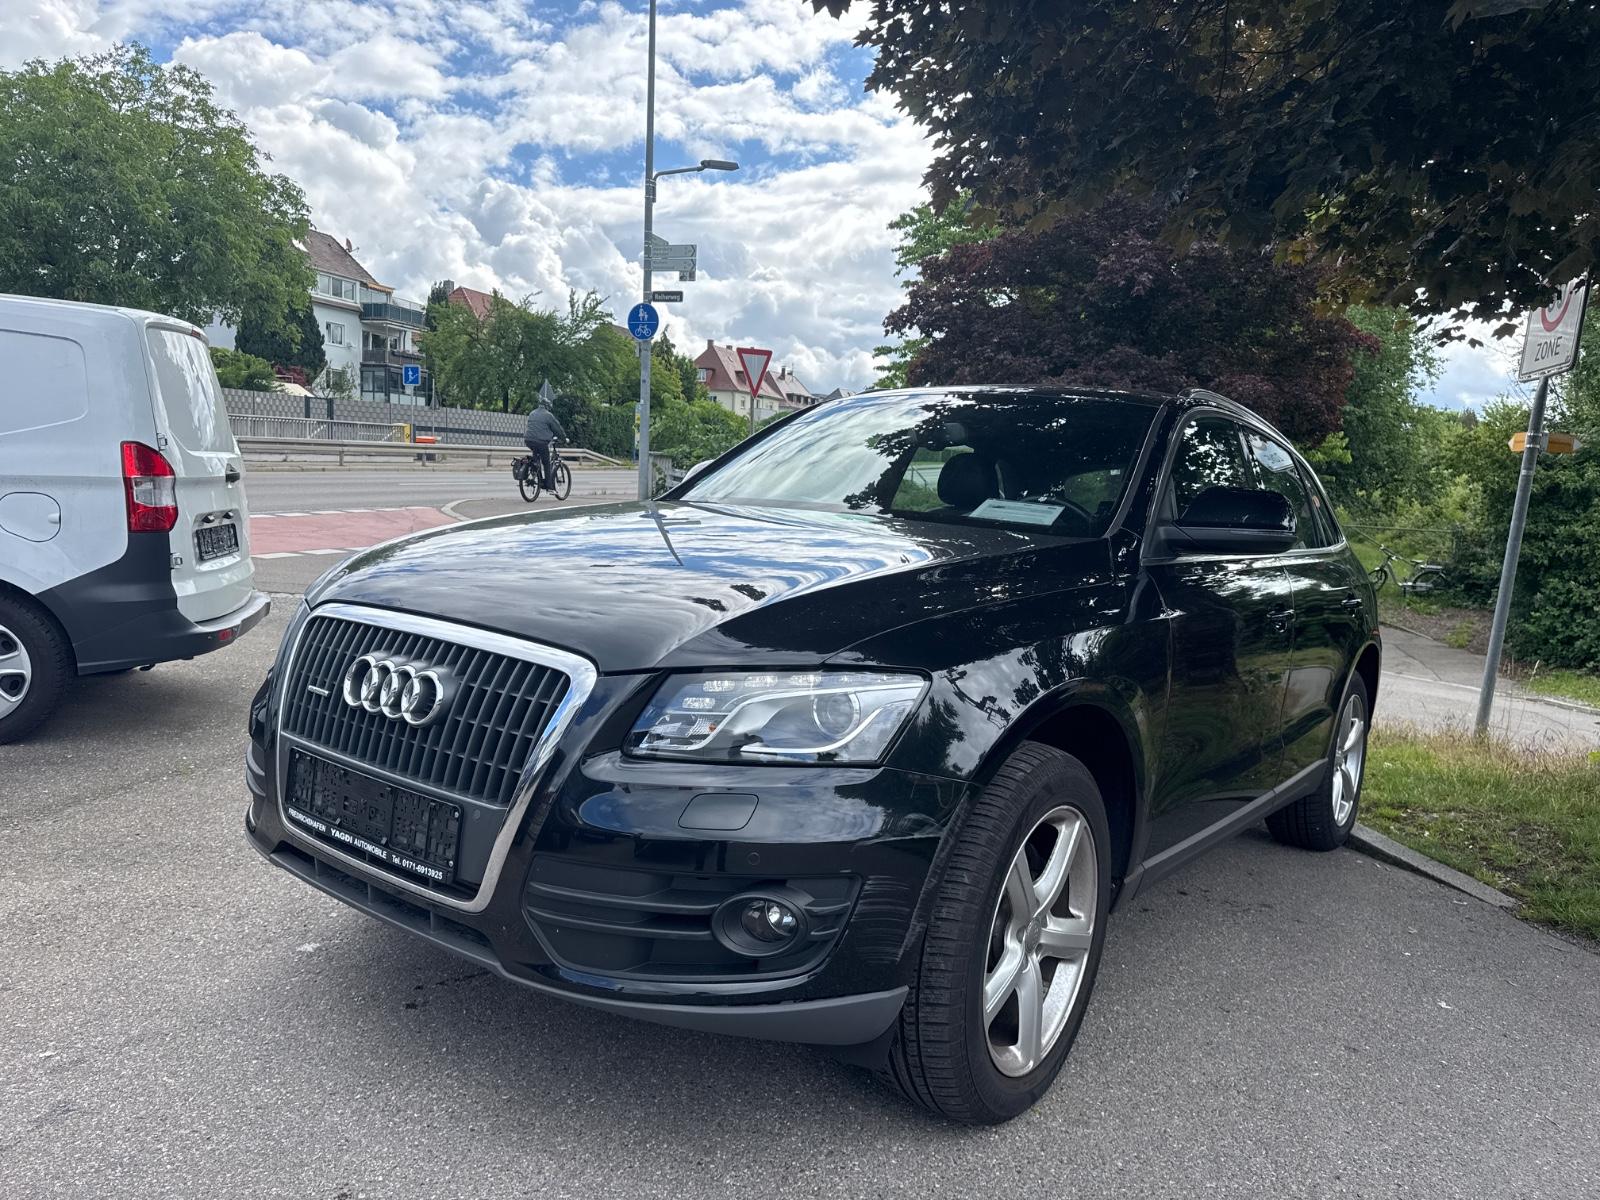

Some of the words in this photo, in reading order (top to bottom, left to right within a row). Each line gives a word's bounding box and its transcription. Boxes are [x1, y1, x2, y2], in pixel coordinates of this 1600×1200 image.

[1534, 336, 1562, 362] ZONE
[330, 827, 353, 844] YAGDI
[353, 838, 388, 860] AUTOMOBILE
[391, 854, 401, 866] Tel.
